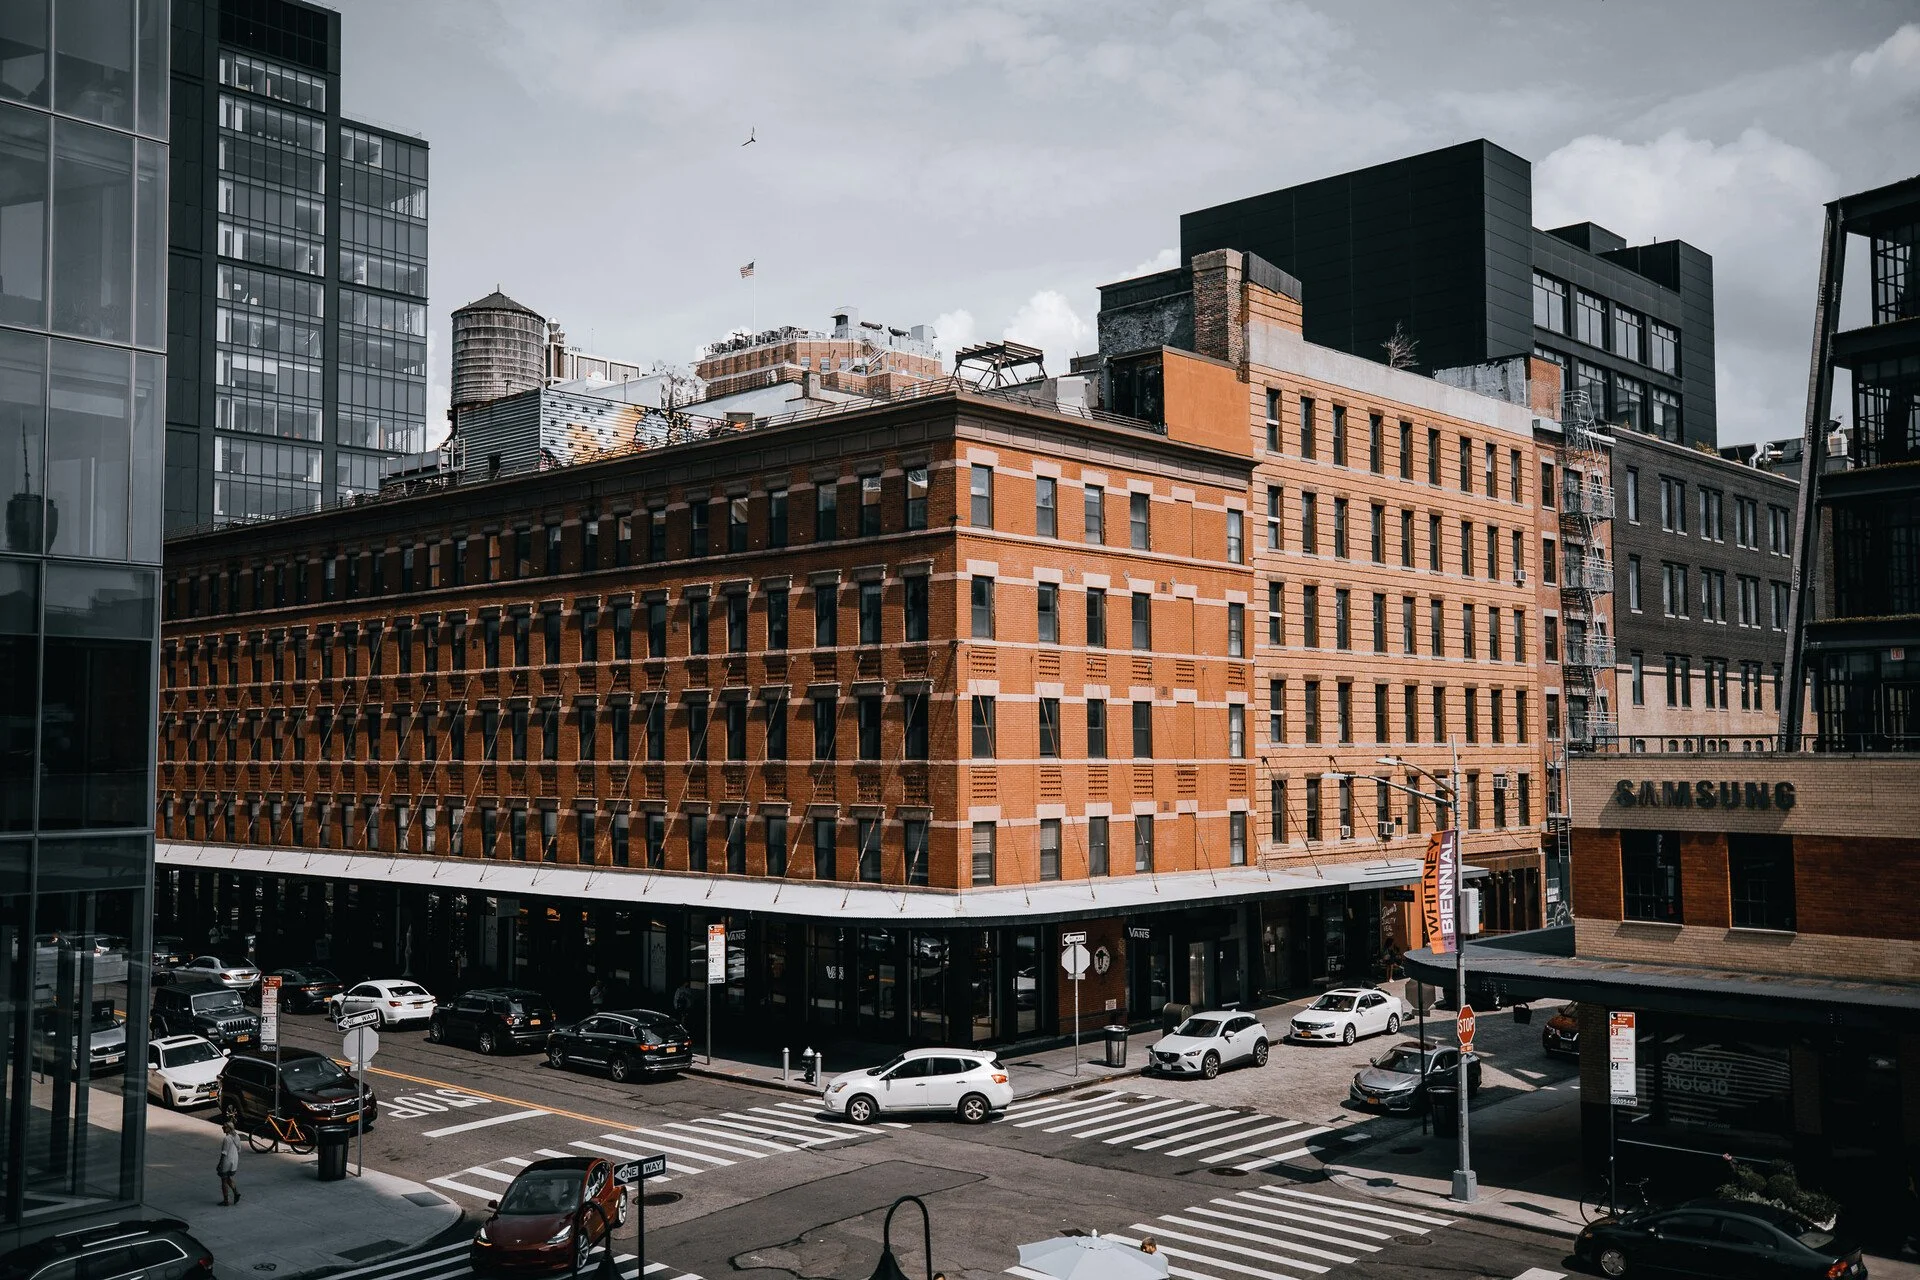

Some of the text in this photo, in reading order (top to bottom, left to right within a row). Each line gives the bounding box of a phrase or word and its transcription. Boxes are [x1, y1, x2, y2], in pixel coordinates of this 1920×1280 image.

[1616, 779, 1796, 811] SAMSUNG
[1422, 838, 1440, 936] WHITNEY
[1439, 835, 1454, 934] BIENNIAL
[726, 929, 747, 941] VANS
[1128, 927, 1150, 939] VANS
[342, 1013, 375, 1027] ONE WAY
[1458, 1016, 1474, 1034] STOP
[1612, 1028, 1617, 1036] 3
[1612, 1062, 1618, 1070] 2
[1665, 1053, 1733, 1079] Galaxy
[1666, 1073, 1729, 1096] Note10
[376, 1088, 493, 1120] STOP
[620, 1161, 662, 1179] ONE WAY
